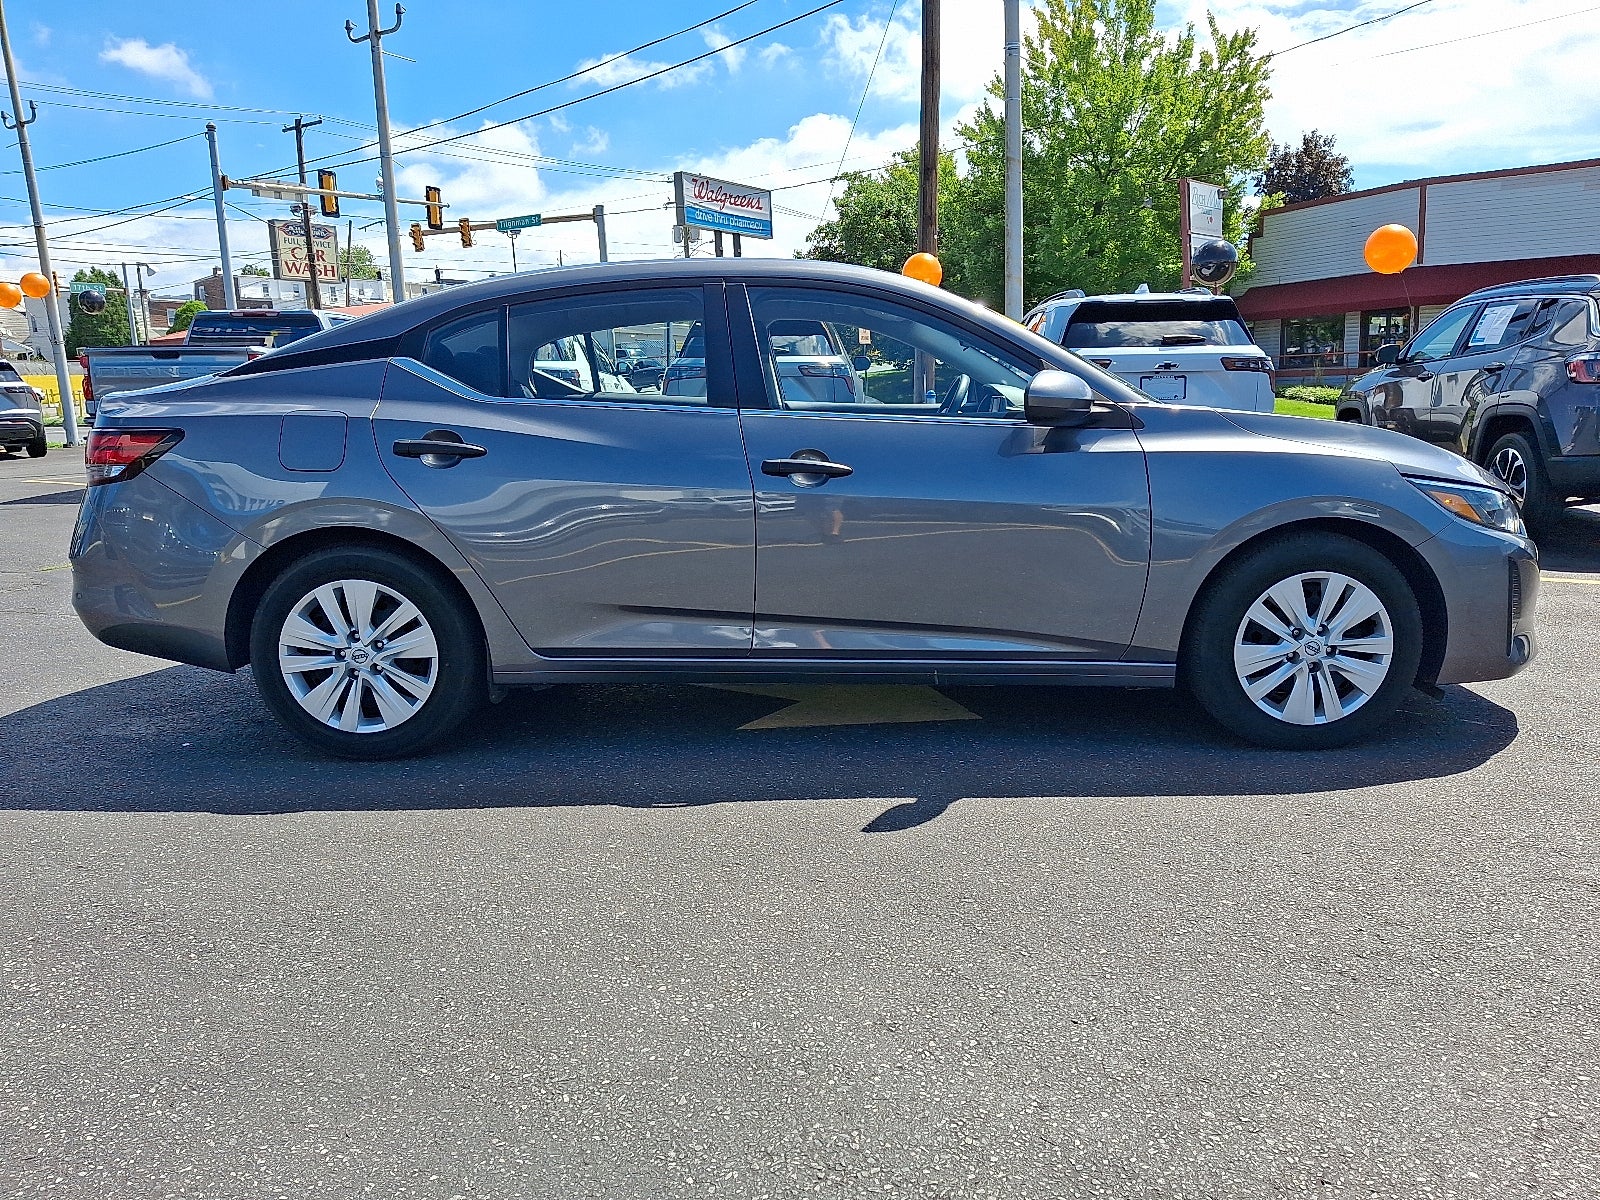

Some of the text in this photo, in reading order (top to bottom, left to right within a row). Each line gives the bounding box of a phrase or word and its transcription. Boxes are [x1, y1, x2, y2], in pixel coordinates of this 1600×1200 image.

[691, 178, 764, 211] Walgreens
[531, 216, 539, 224] St
[695, 209, 763, 232] drive thru pharmacy
[283, 237, 332, 249] FULL SVICE
[290, 246, 327, 263] CR
[284, 260, 336, 278] WASH
